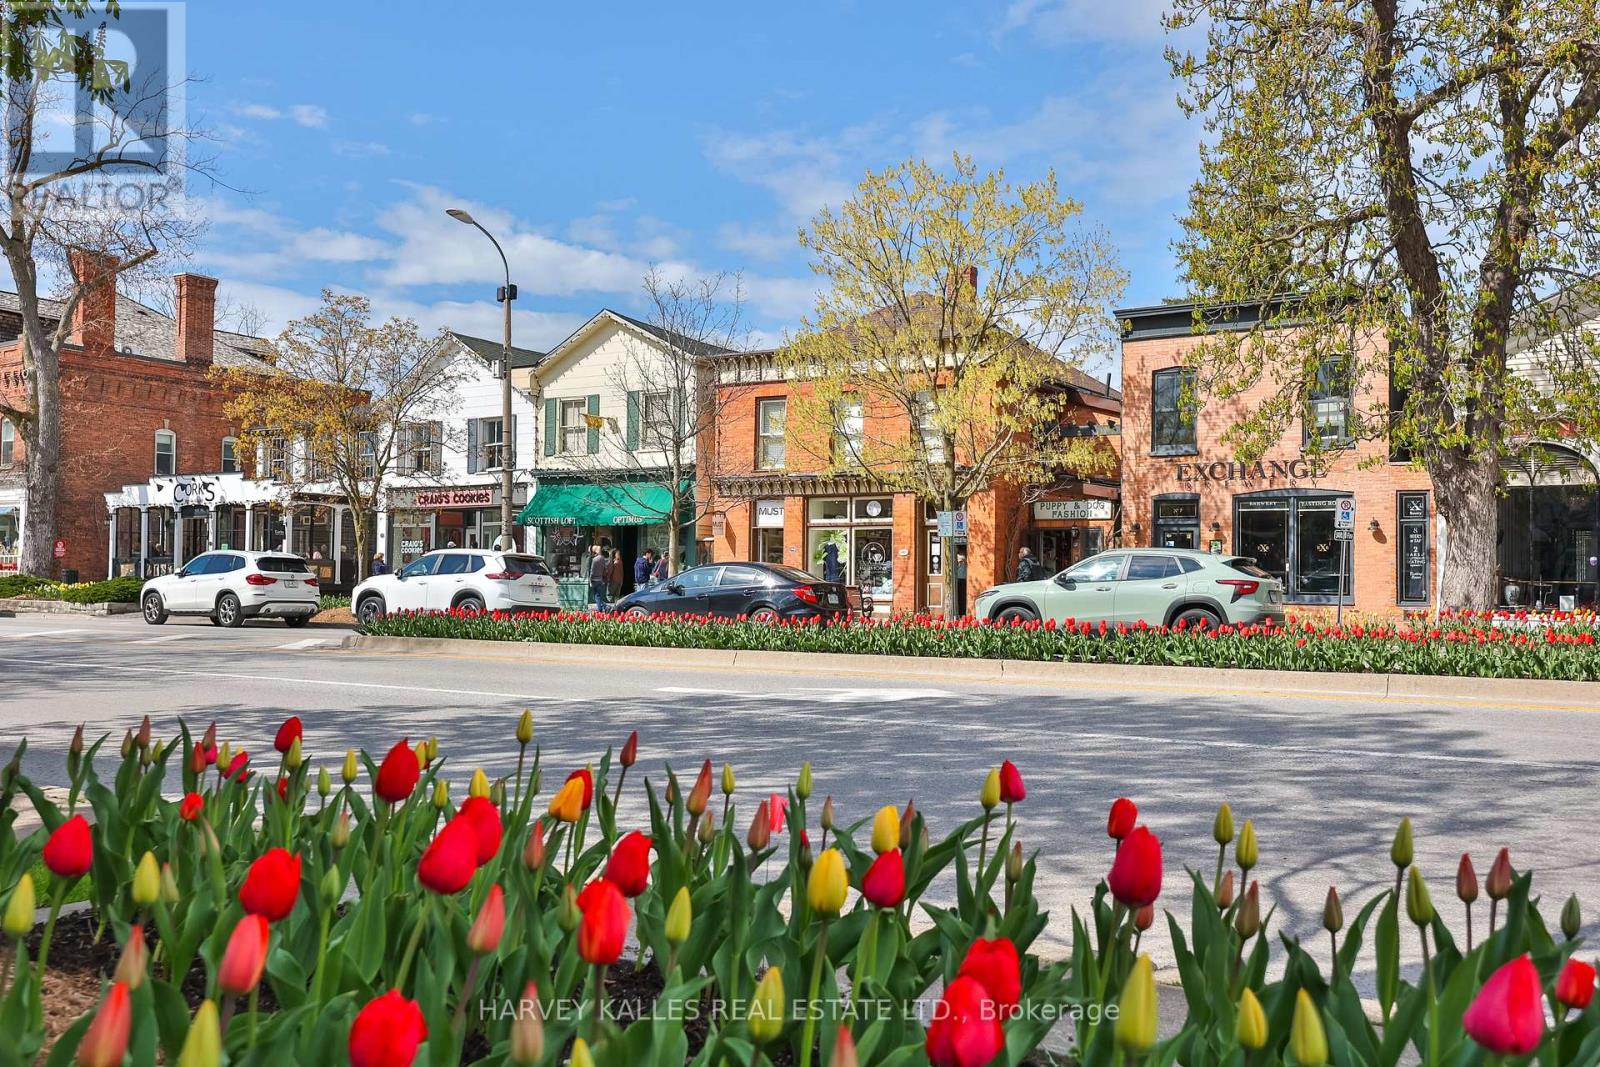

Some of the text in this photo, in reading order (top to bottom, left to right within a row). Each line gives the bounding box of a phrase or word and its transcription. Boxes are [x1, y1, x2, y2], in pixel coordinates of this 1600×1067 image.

[1175, 458, 1329, 481] EXCHANGE
[1184, 477, 1319, 492] BREWERY
[418, 494, 450, 505] CRAIG'S
[1040, 502, 1067, 510] PUPPY
[1086, 501, 1105, 509] DOG
[758, 507, 784, 516] MUST
[1052, 510, 1093, 518] FASHION
[527, 516, 576, 525] SCOTTISH LOFT
